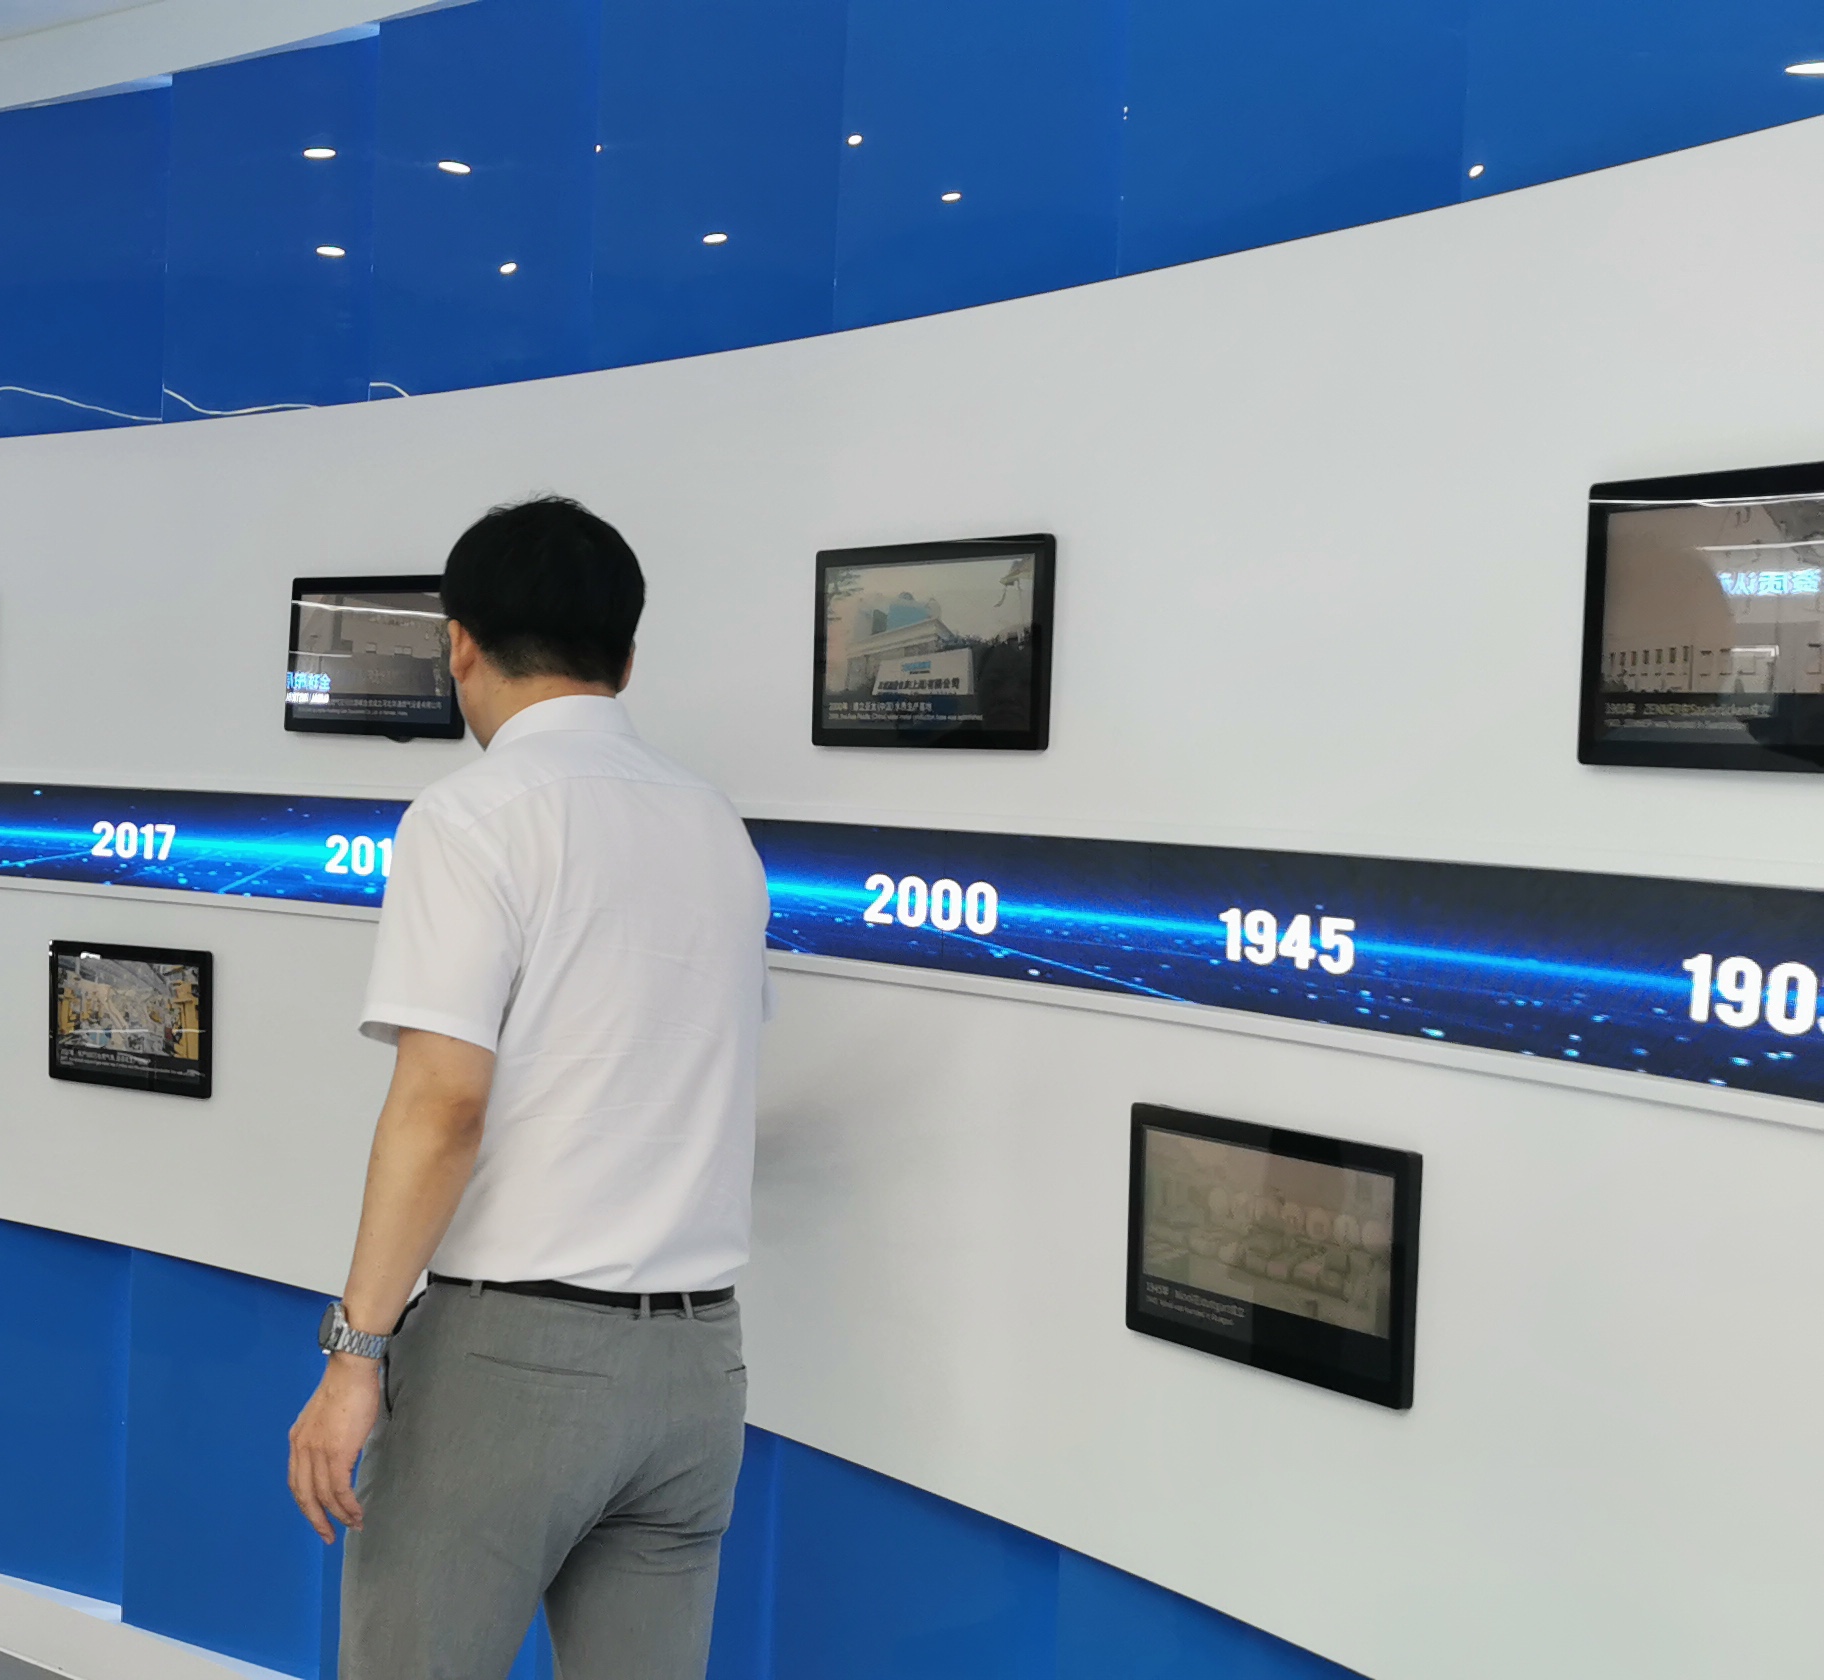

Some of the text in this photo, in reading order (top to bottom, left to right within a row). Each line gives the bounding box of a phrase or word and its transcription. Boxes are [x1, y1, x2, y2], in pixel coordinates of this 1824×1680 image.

[91, 821, 176, 860] 2017
[325, 835, 392, 877] 201
[863, 874, 998, 935] 2000
[1219, 908, 1356, 975] 1945
[1682, 953, 1824, 1036] 190
